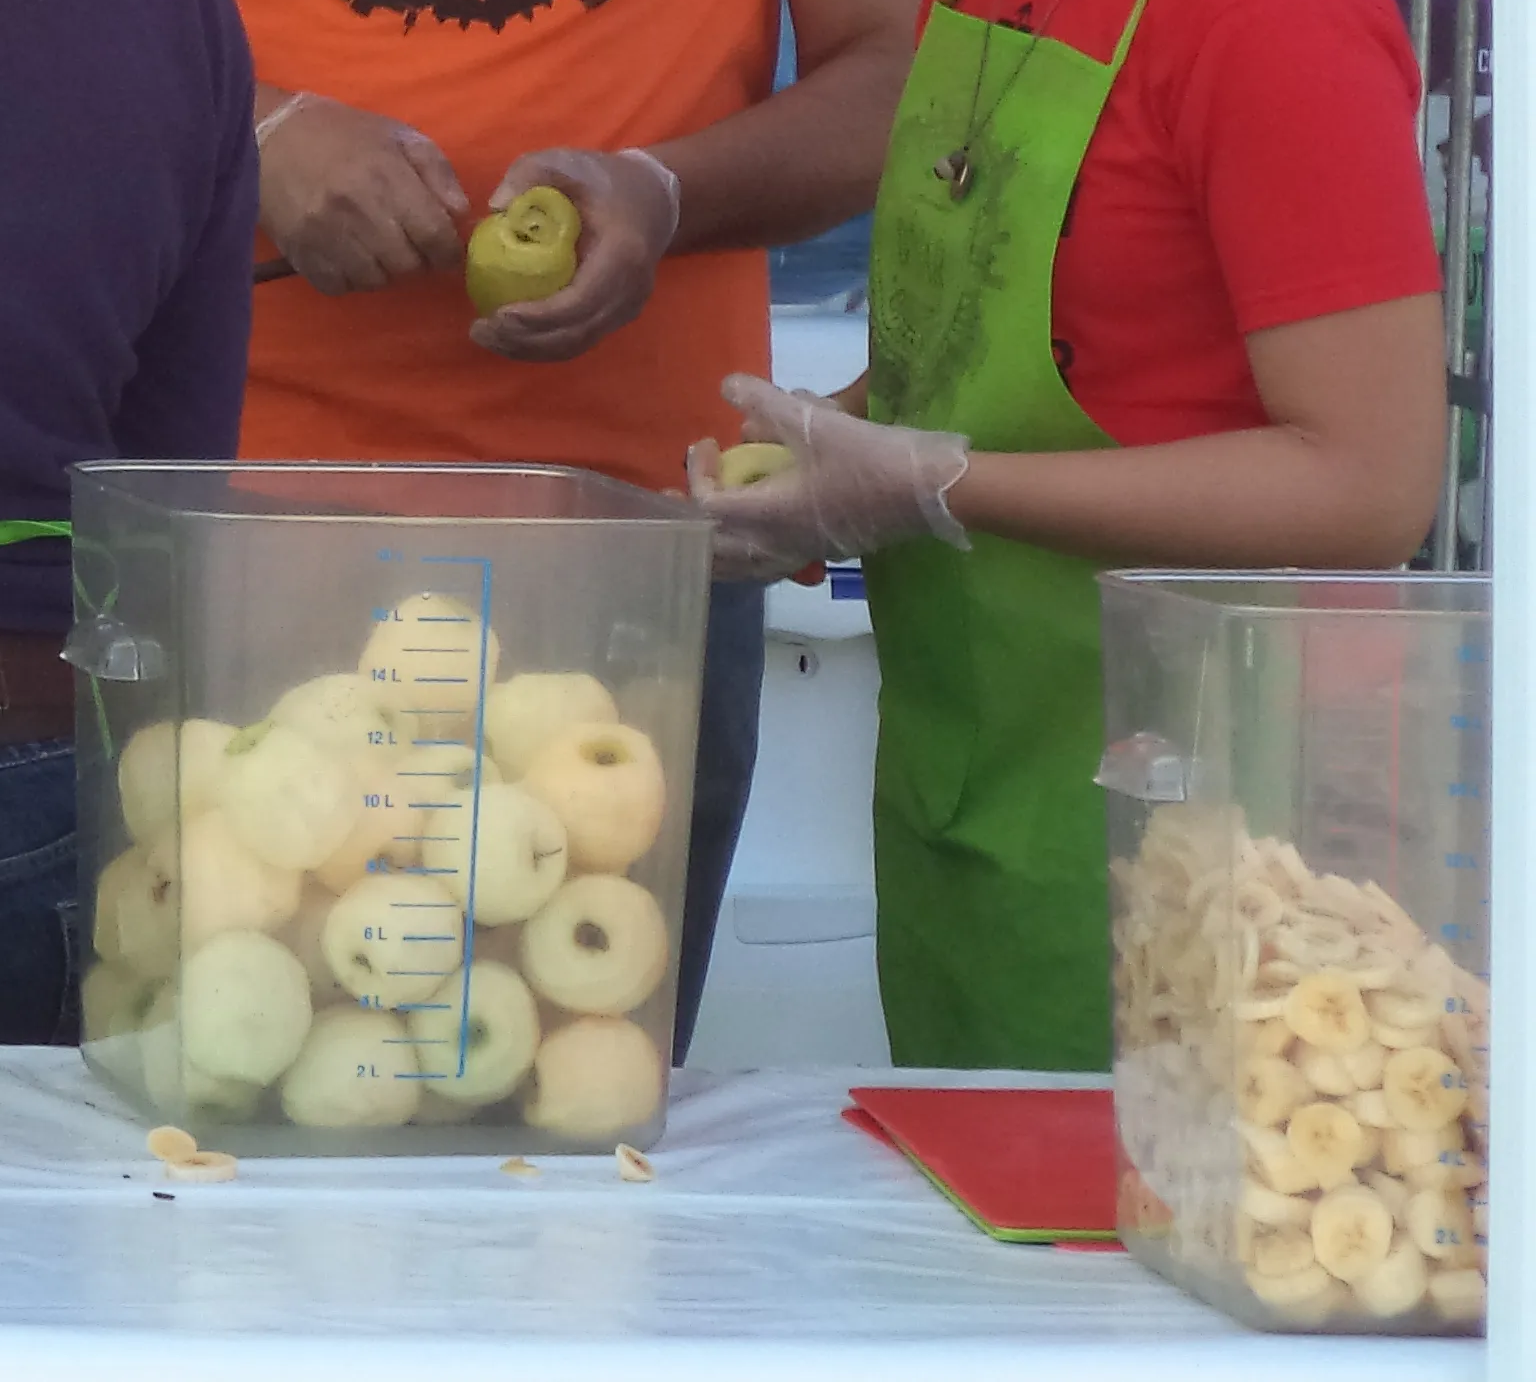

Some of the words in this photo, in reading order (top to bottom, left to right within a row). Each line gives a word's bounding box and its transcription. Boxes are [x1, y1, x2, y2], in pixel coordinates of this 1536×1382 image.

[372, 668, 386, 682] 14
[392, 668, 401, 682] L
[367, 731, 383, 745] 12
[388, 731, 397, 745] L
[363, 794, 380, 808] 10
[385, 794, 394, 808] L
[364, 926, 373, 940] 6
[378, 926, 387, 940] L
[356, 1065, 365, 1078] 2
[371, 1064, 379, 1078] L
